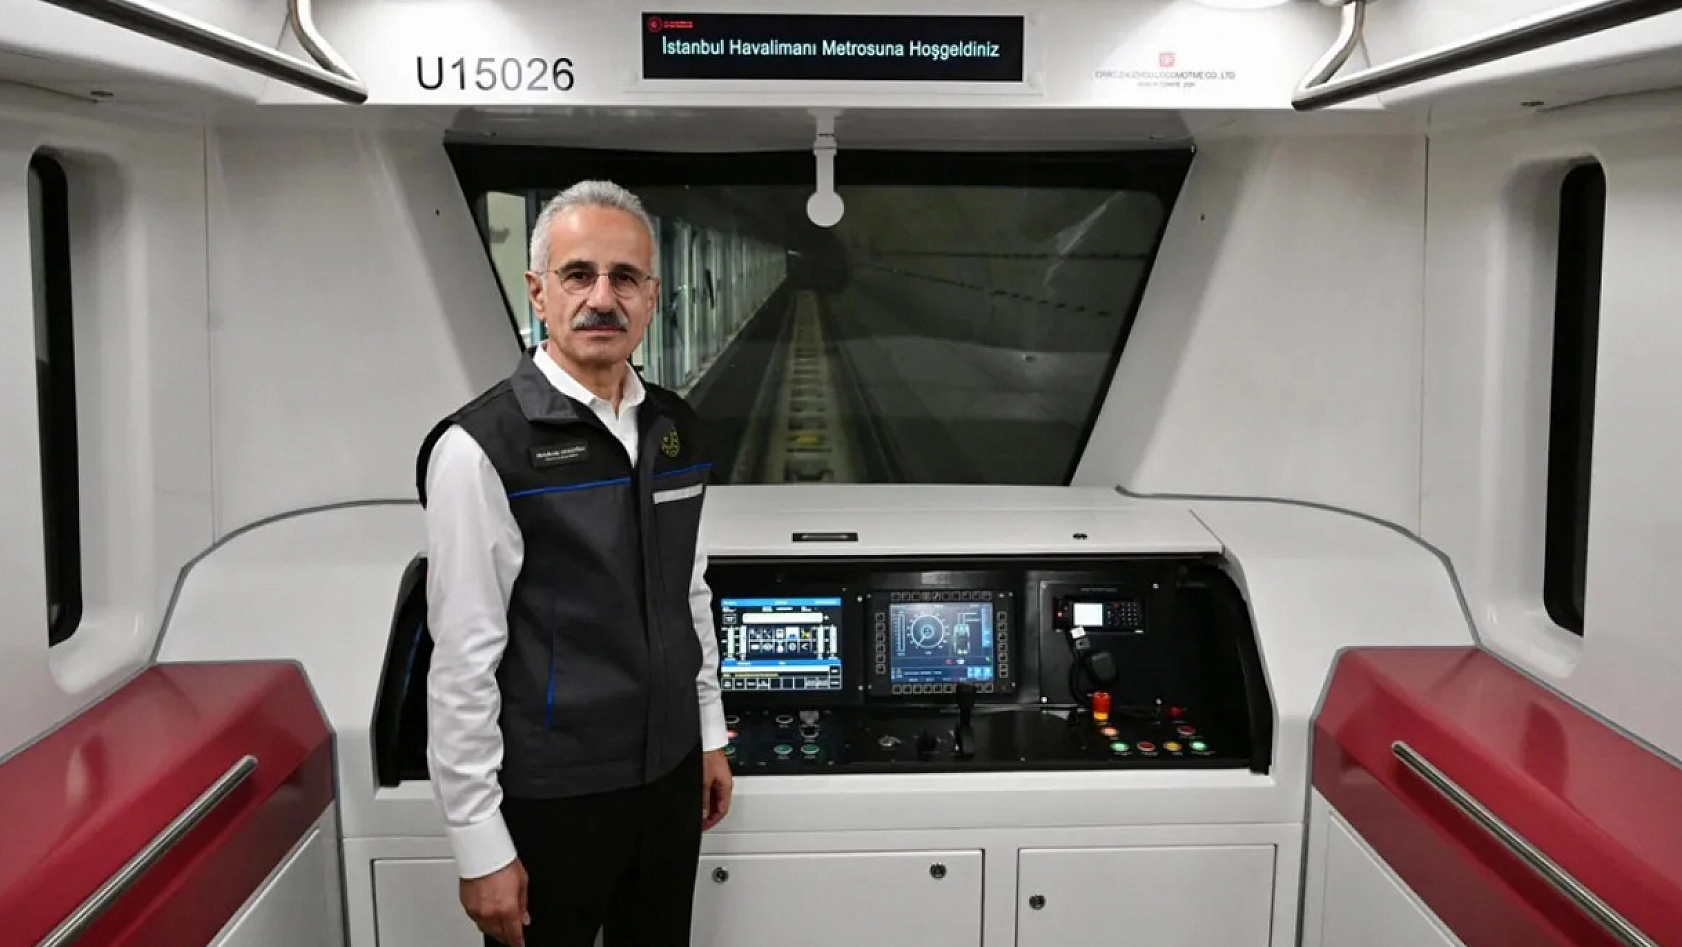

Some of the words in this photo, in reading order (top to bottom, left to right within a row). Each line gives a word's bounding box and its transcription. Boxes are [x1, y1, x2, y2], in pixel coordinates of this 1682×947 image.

[662, 35, 724, 55] İstanbul
[730, 38, 817, 56] Havalimanı
[822, 39, 904, 57] Metrosuna
[909, 40, 1000, 60] Hoşgeldiniz
[416, 56, 575, 91] U15026
